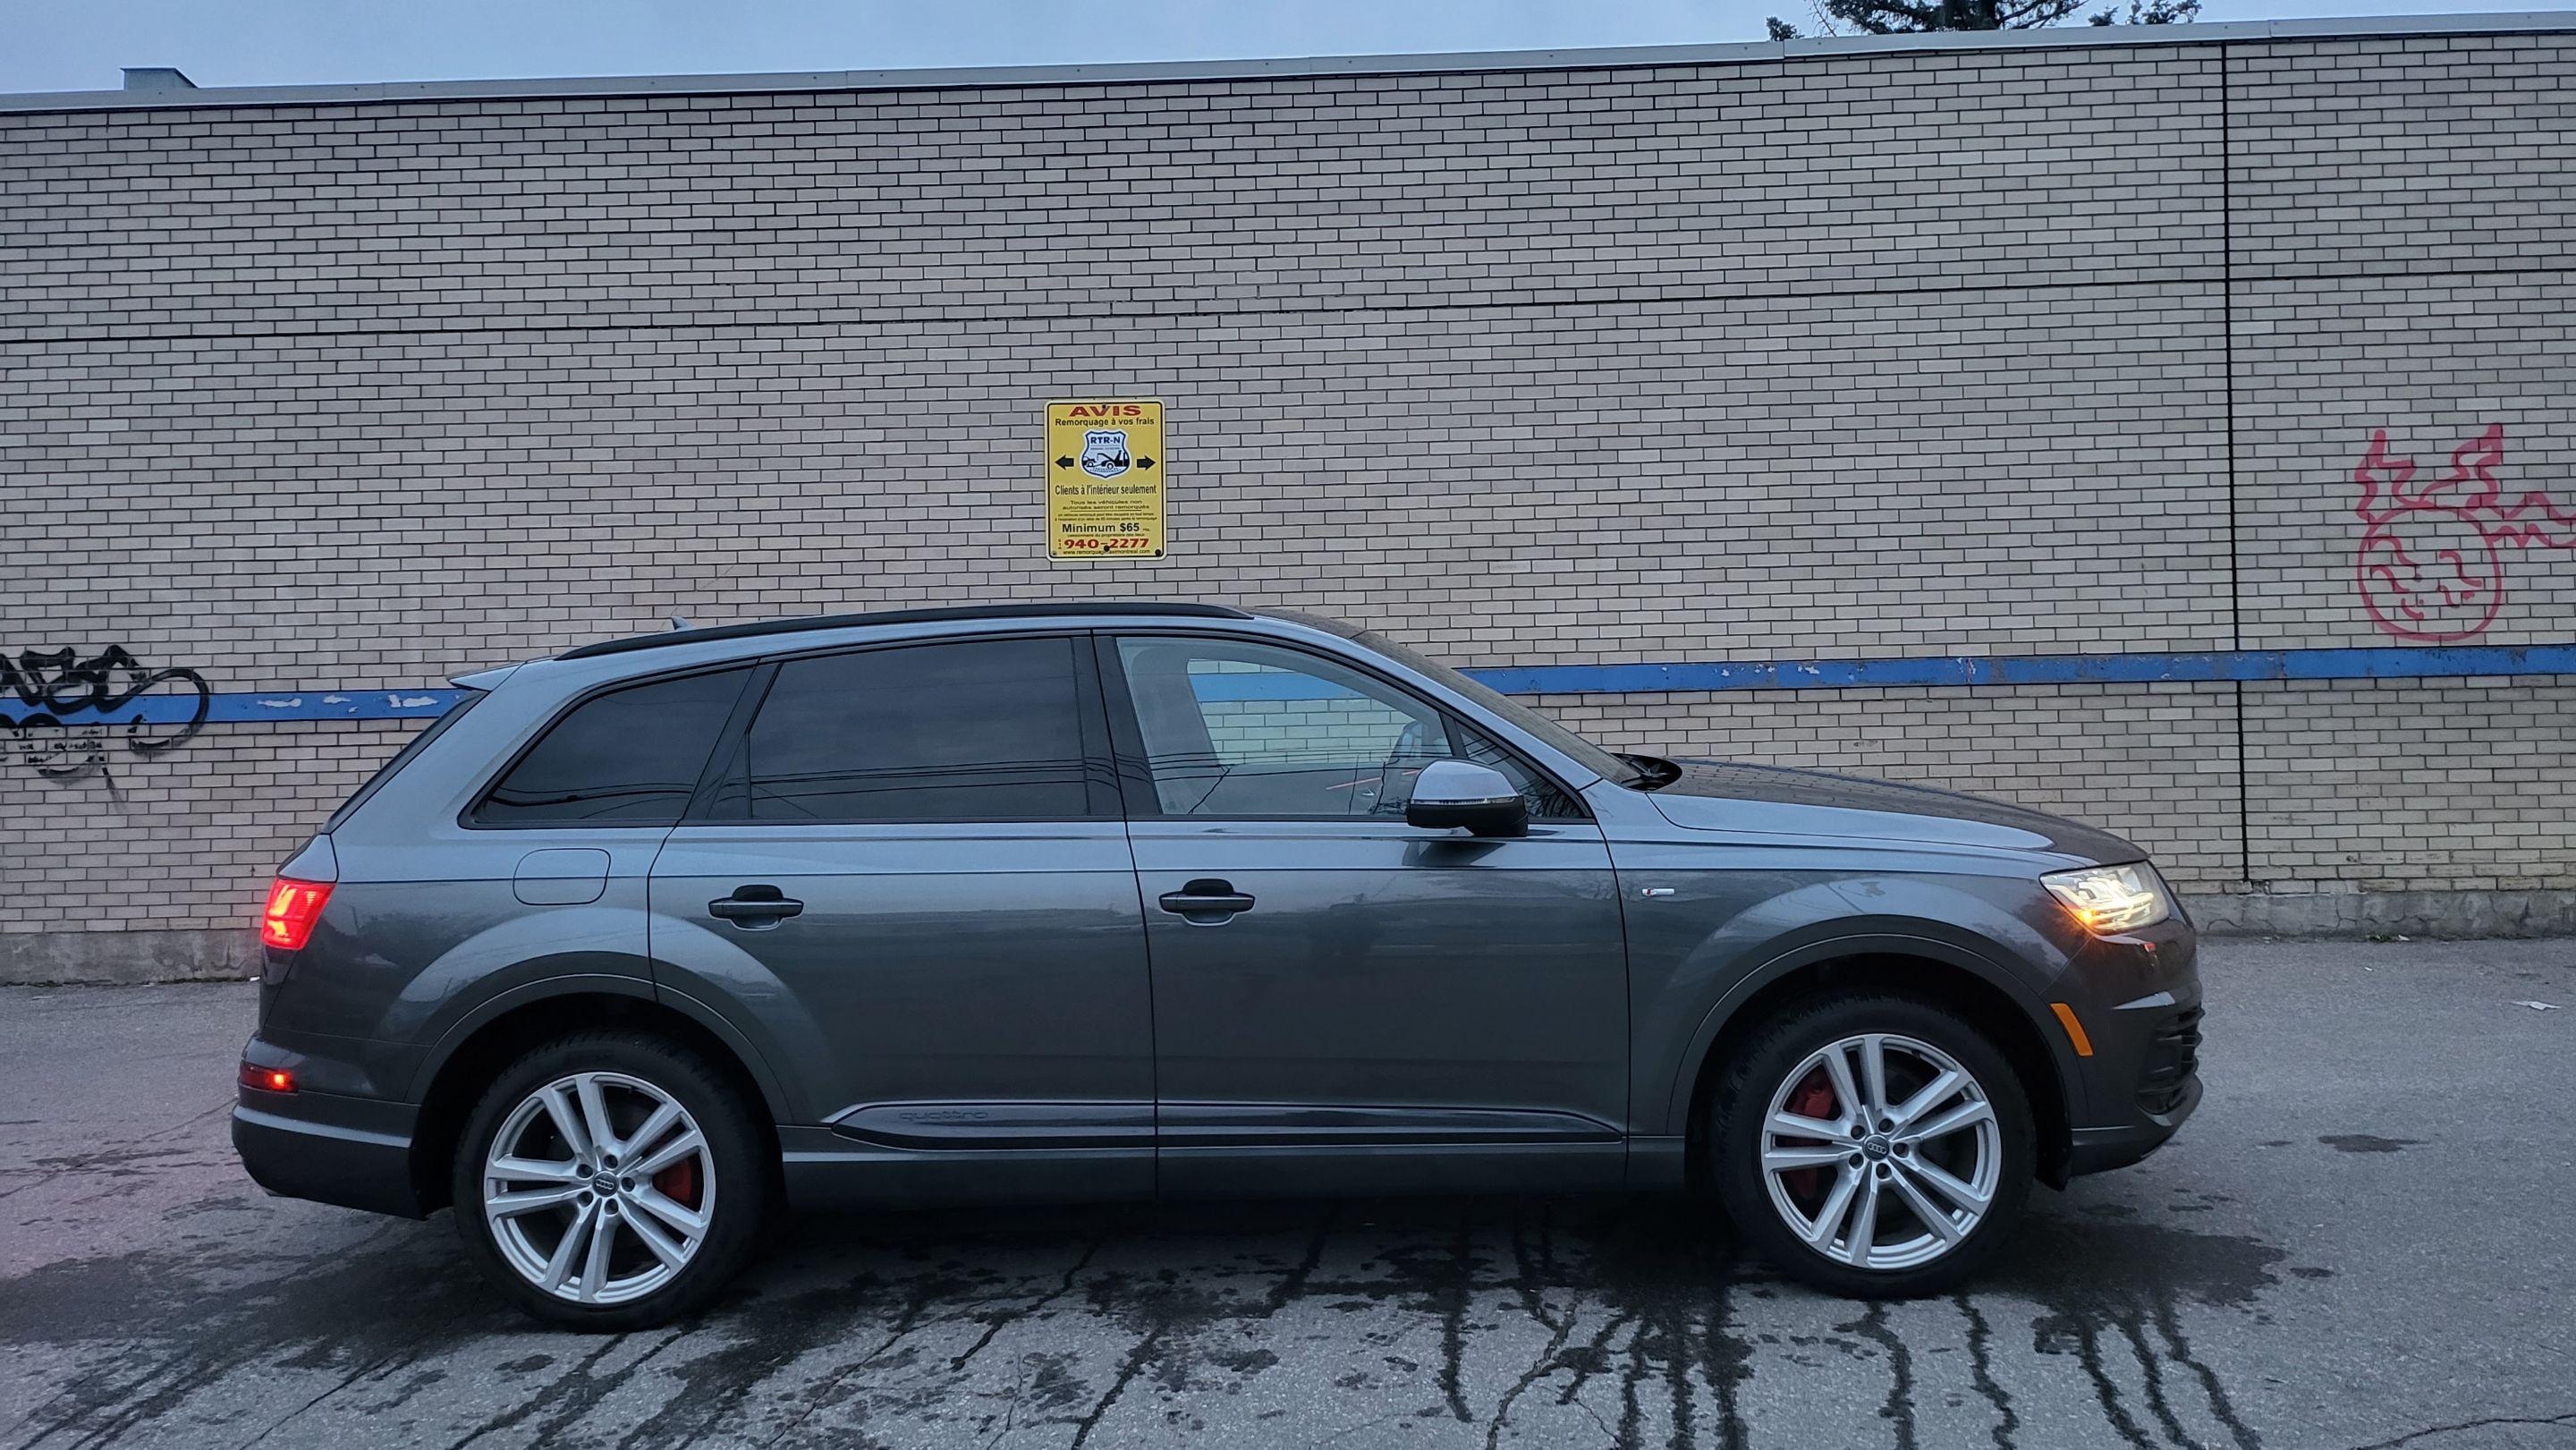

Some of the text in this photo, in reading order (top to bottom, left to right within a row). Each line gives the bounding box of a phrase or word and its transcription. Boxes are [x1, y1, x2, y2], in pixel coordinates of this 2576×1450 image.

[1069, 404, 1141, 417] AVIS
[1055, 418, 1109, 427] Remorquage
[1136, 417, 1155, 425] frais
[1055, 484, 1157, 496] Clients à l'intérieur seulement
[1062, 522, 1115, 532] Minimum
[1119, 522, 1140, 532] $65
[1063, 538, 1149, 549] 940-2277
[898, 1110, 988, 1122] quattro
